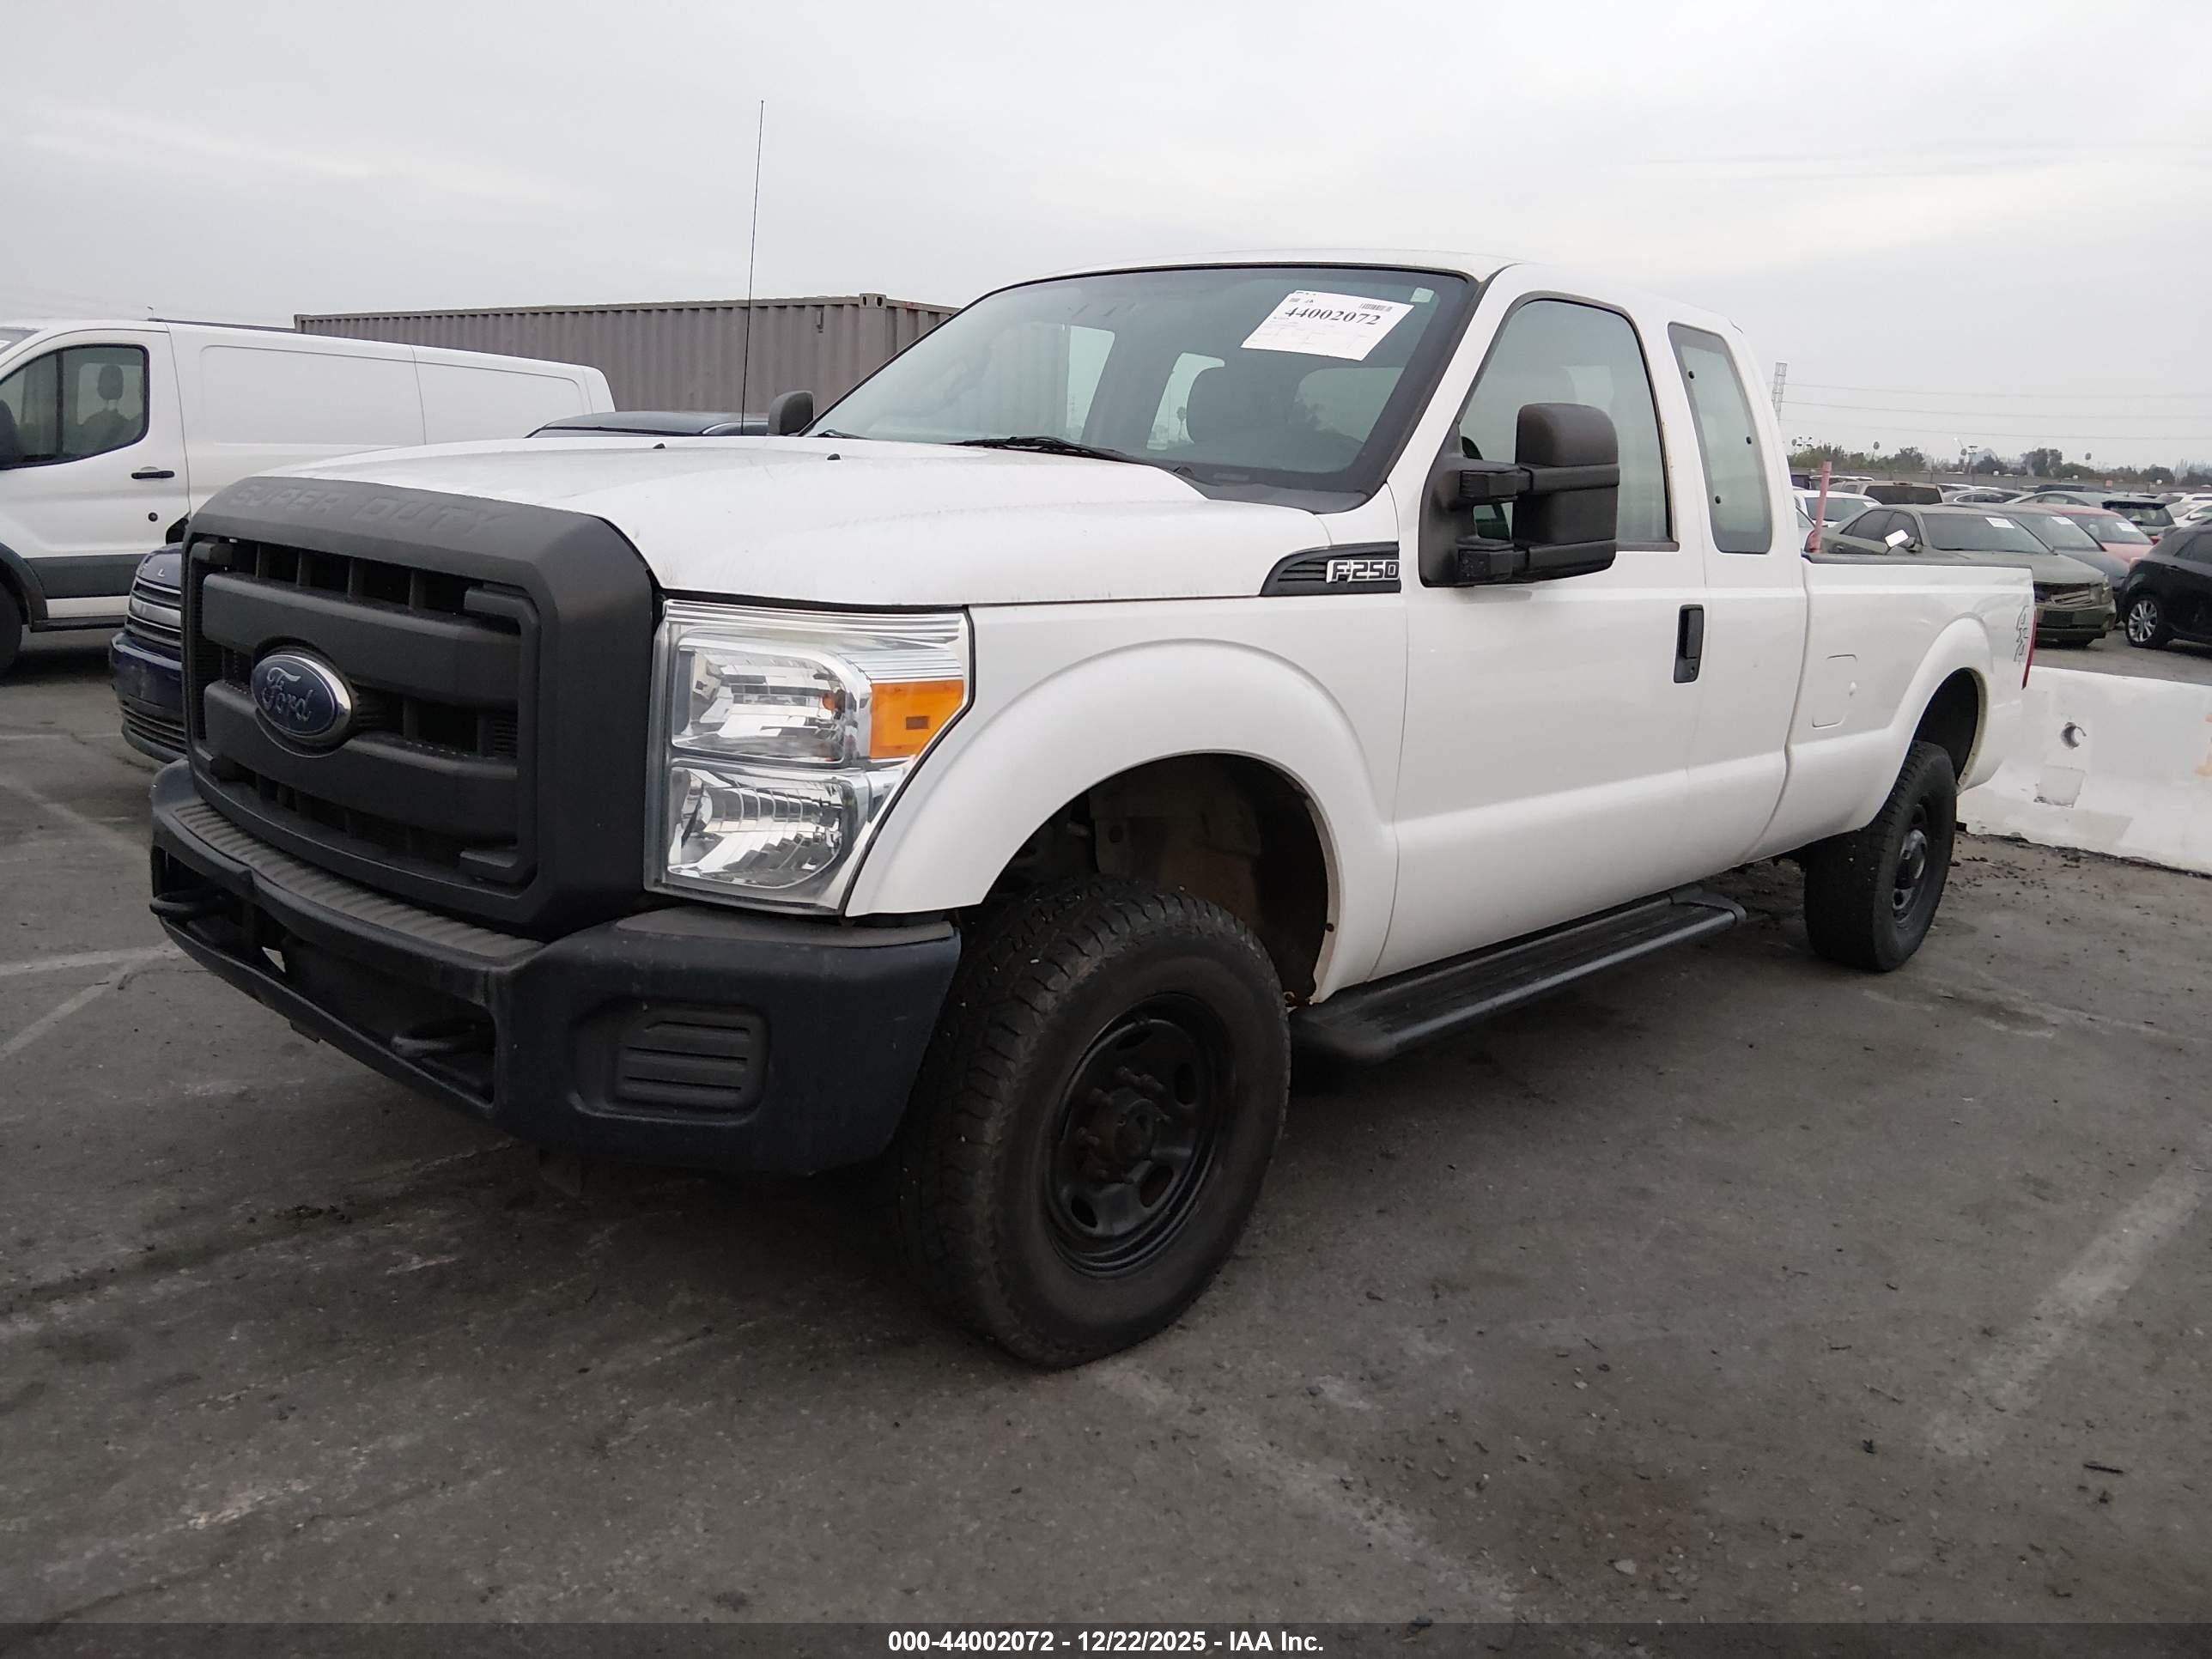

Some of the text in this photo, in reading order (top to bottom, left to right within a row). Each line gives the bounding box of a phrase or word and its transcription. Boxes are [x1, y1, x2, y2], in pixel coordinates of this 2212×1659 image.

[1285, 307, 1381, 325] 44002072
[230, 484, 508, 536] SUPER DUTY
[260, 666, 314, 722] Ford
